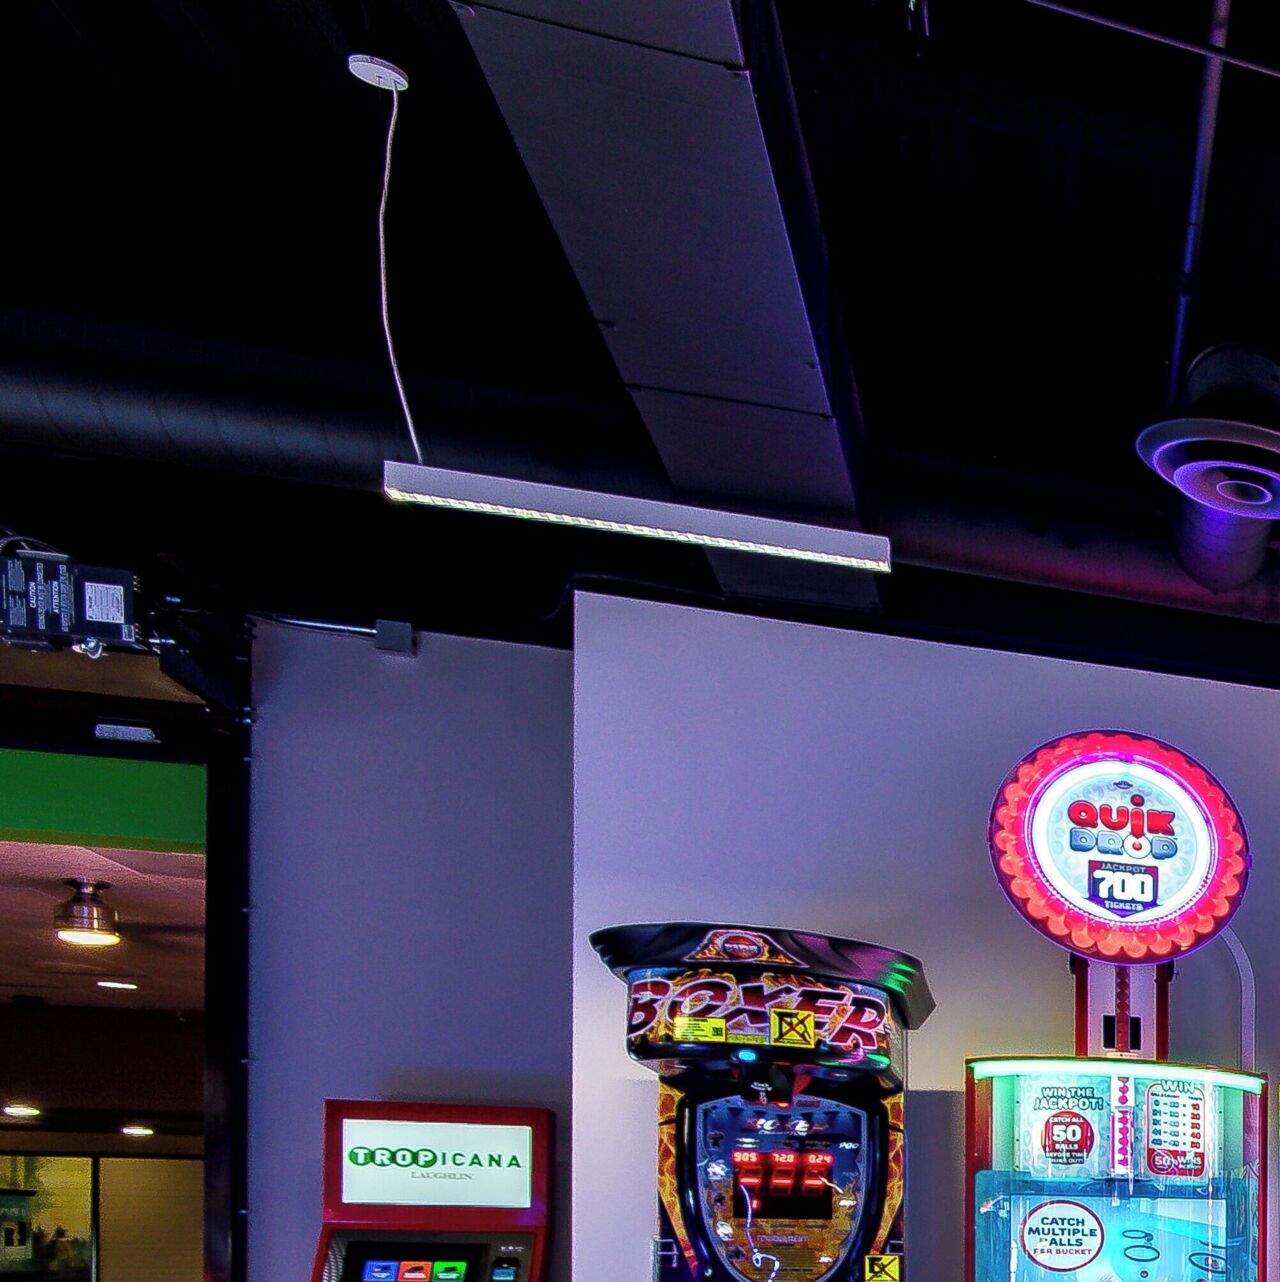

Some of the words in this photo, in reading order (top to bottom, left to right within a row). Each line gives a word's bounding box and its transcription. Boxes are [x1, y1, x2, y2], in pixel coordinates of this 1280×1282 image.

[29, 581, 37, 608] CAUTION
[52, 581, 60, 614] ATTENTION
[1070, 828, 1178, 860] DROP
[1101, 863, 1147, 873] JACKPOT
[1094, 870, 1153, 902] 700
[1104, 900, 1143, 911] TICKETS
[628, 978, 888, 1050] BOXER
[1042, 1087, 1067, 1098] WIN
[1068, 1087, 1094, 1098] THE
[1161, 1080, 1195, 1094] WIN
[1033, 1097, 1104, 1110] JACKPOT!
[1052, 1125, 1082, 1143] 50
[349, 1146, 522, 1168] TROPICANA
[411, 1171, 473, 1180] LAUGHLIN
[1041, 1216, 1085, 1226] CATCH
[1028, 1227, 1097, 1237] MULTIPLE
[1040, 1237, 1083, 1247] ALLS
